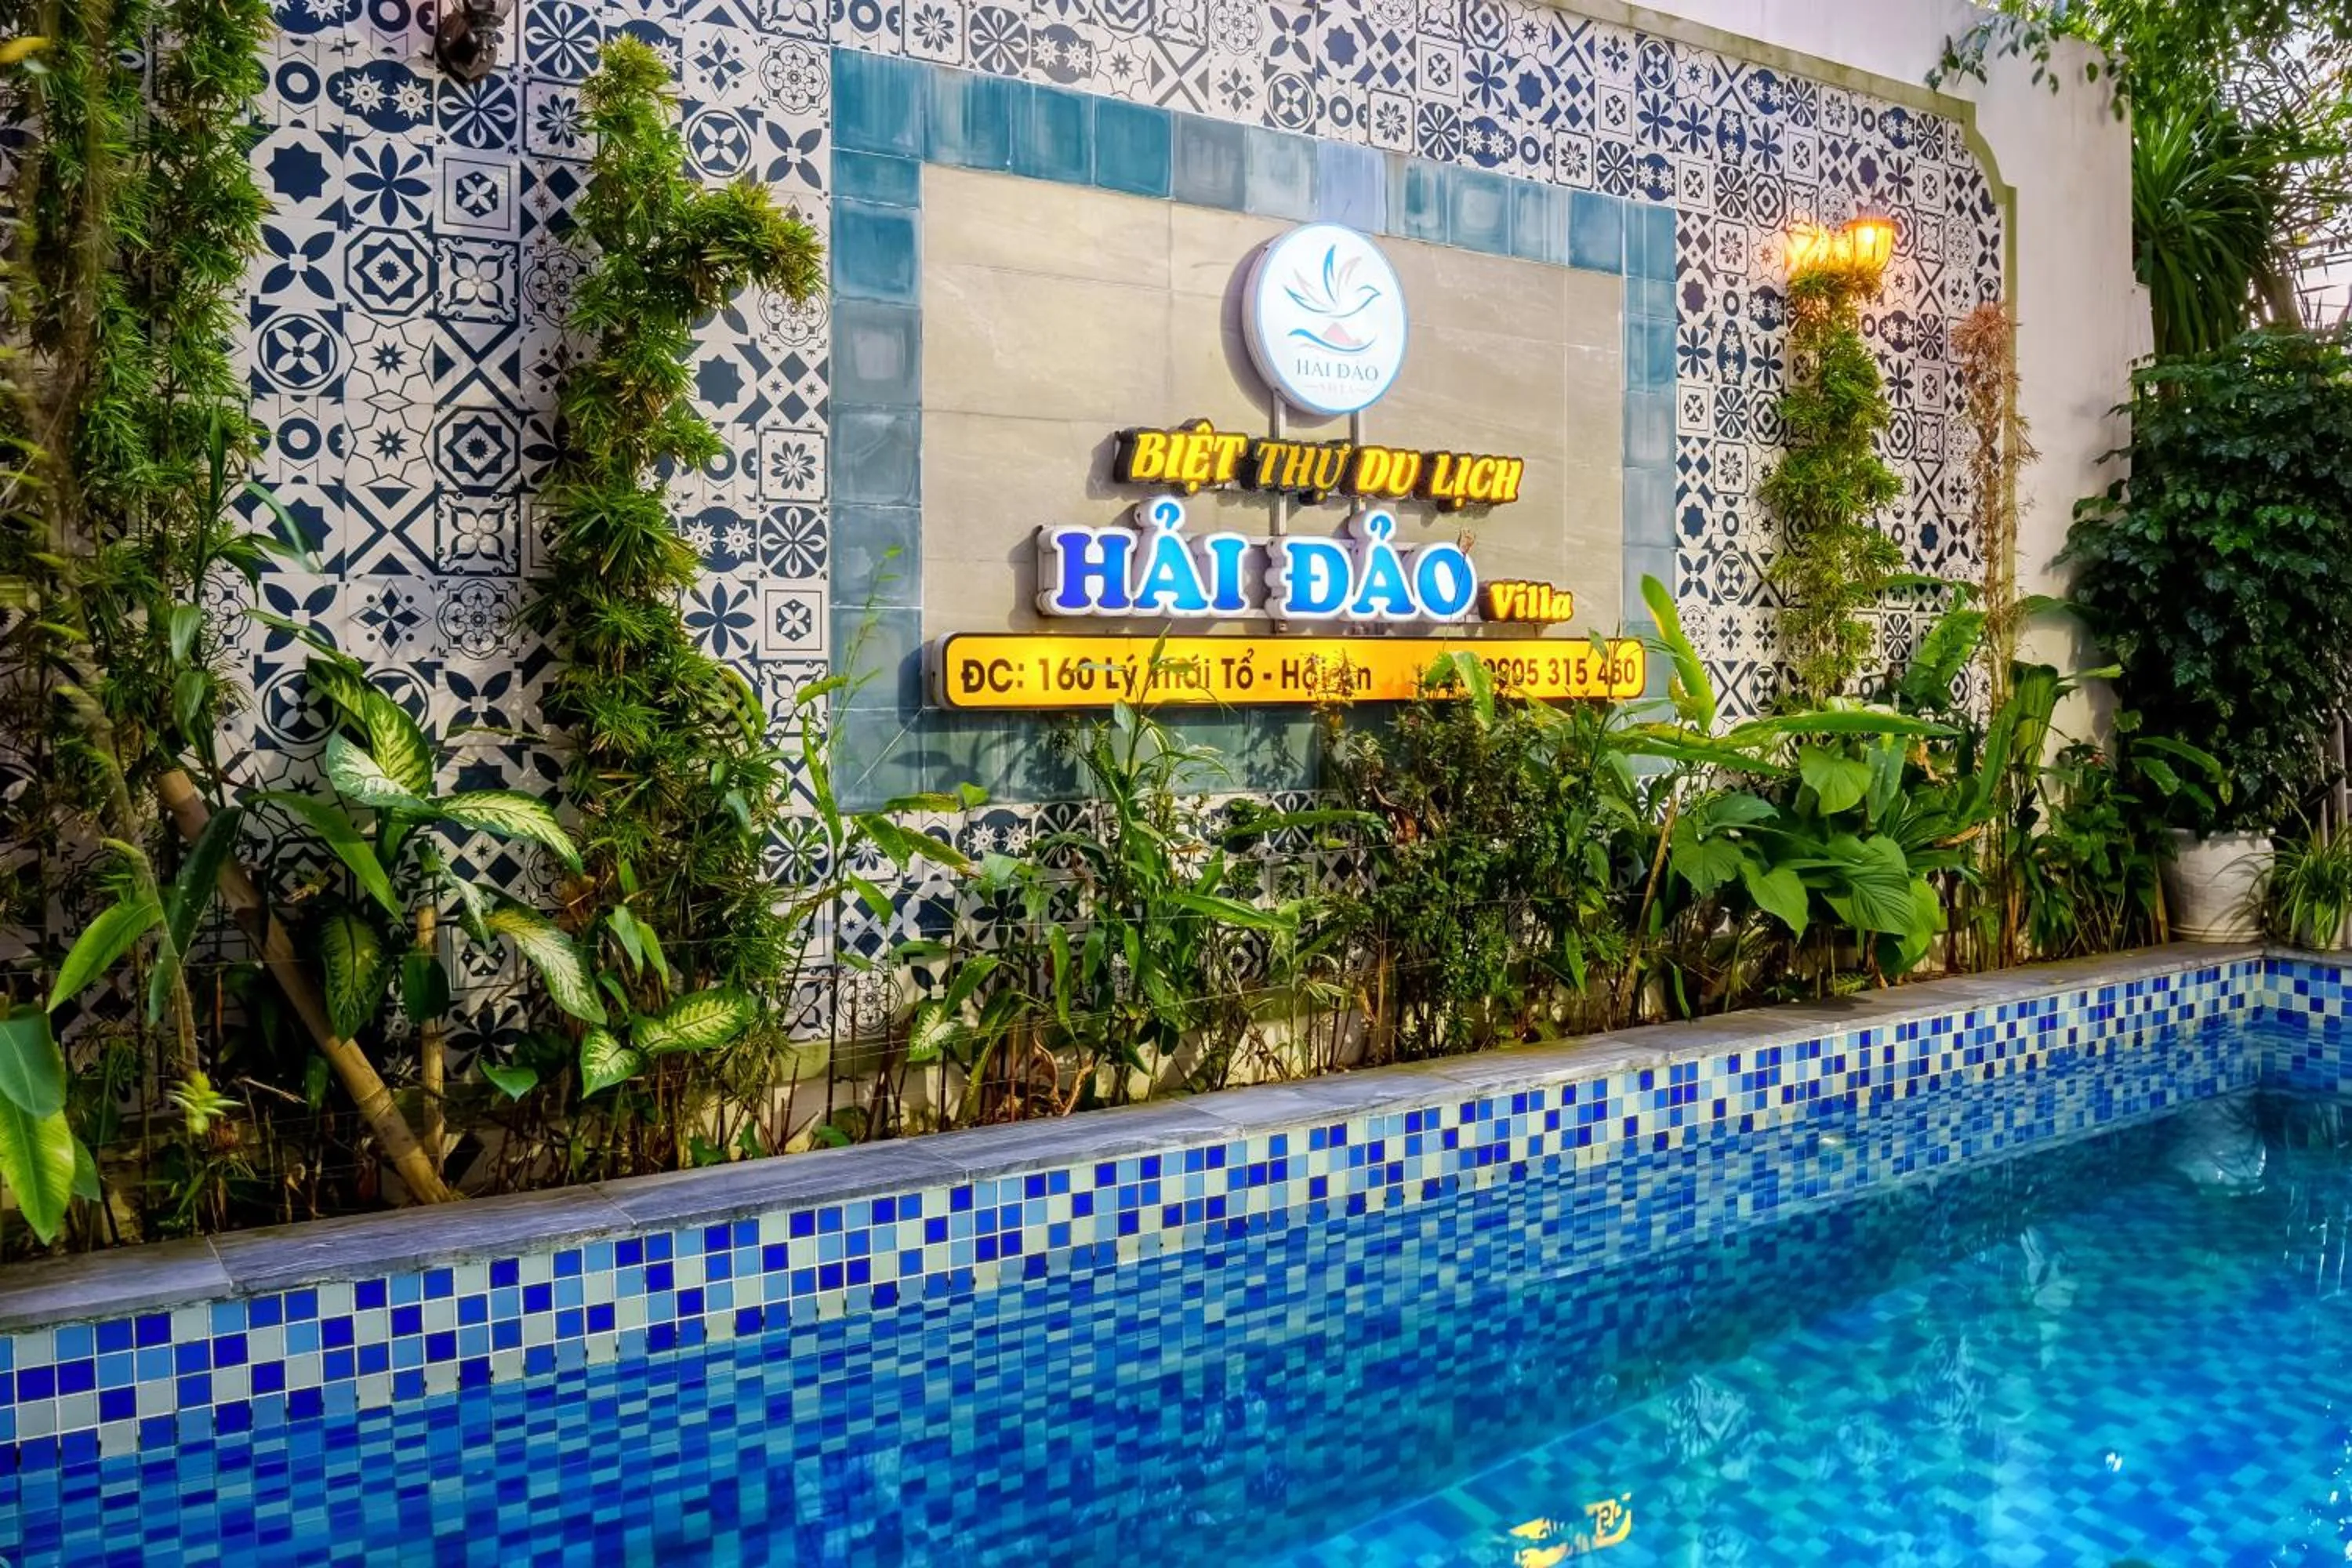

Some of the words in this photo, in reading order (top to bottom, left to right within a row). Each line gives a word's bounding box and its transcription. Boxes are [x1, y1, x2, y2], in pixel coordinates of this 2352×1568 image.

[1131, 420, 1247, 495] BIỆT
[1257, 442, 1351, 501] THỰ
[1358, 448, 1418, 498] DU
[1429, 453, 1523, 508] LỊCH
[1055, 501, 1247, 615] HẢI
[1284, 514, 1475, 617] ĐẢO
[1491, 579, 1573, 621] Villa
[960, 658, 1025, 692] ĐC:
[1037, 656, 1095, 691] 160
[1105, 655, 1138, 697] Lý
[1221, 648, 1254, 690] Tổ
[1548, 658, 1588, 686] 315
